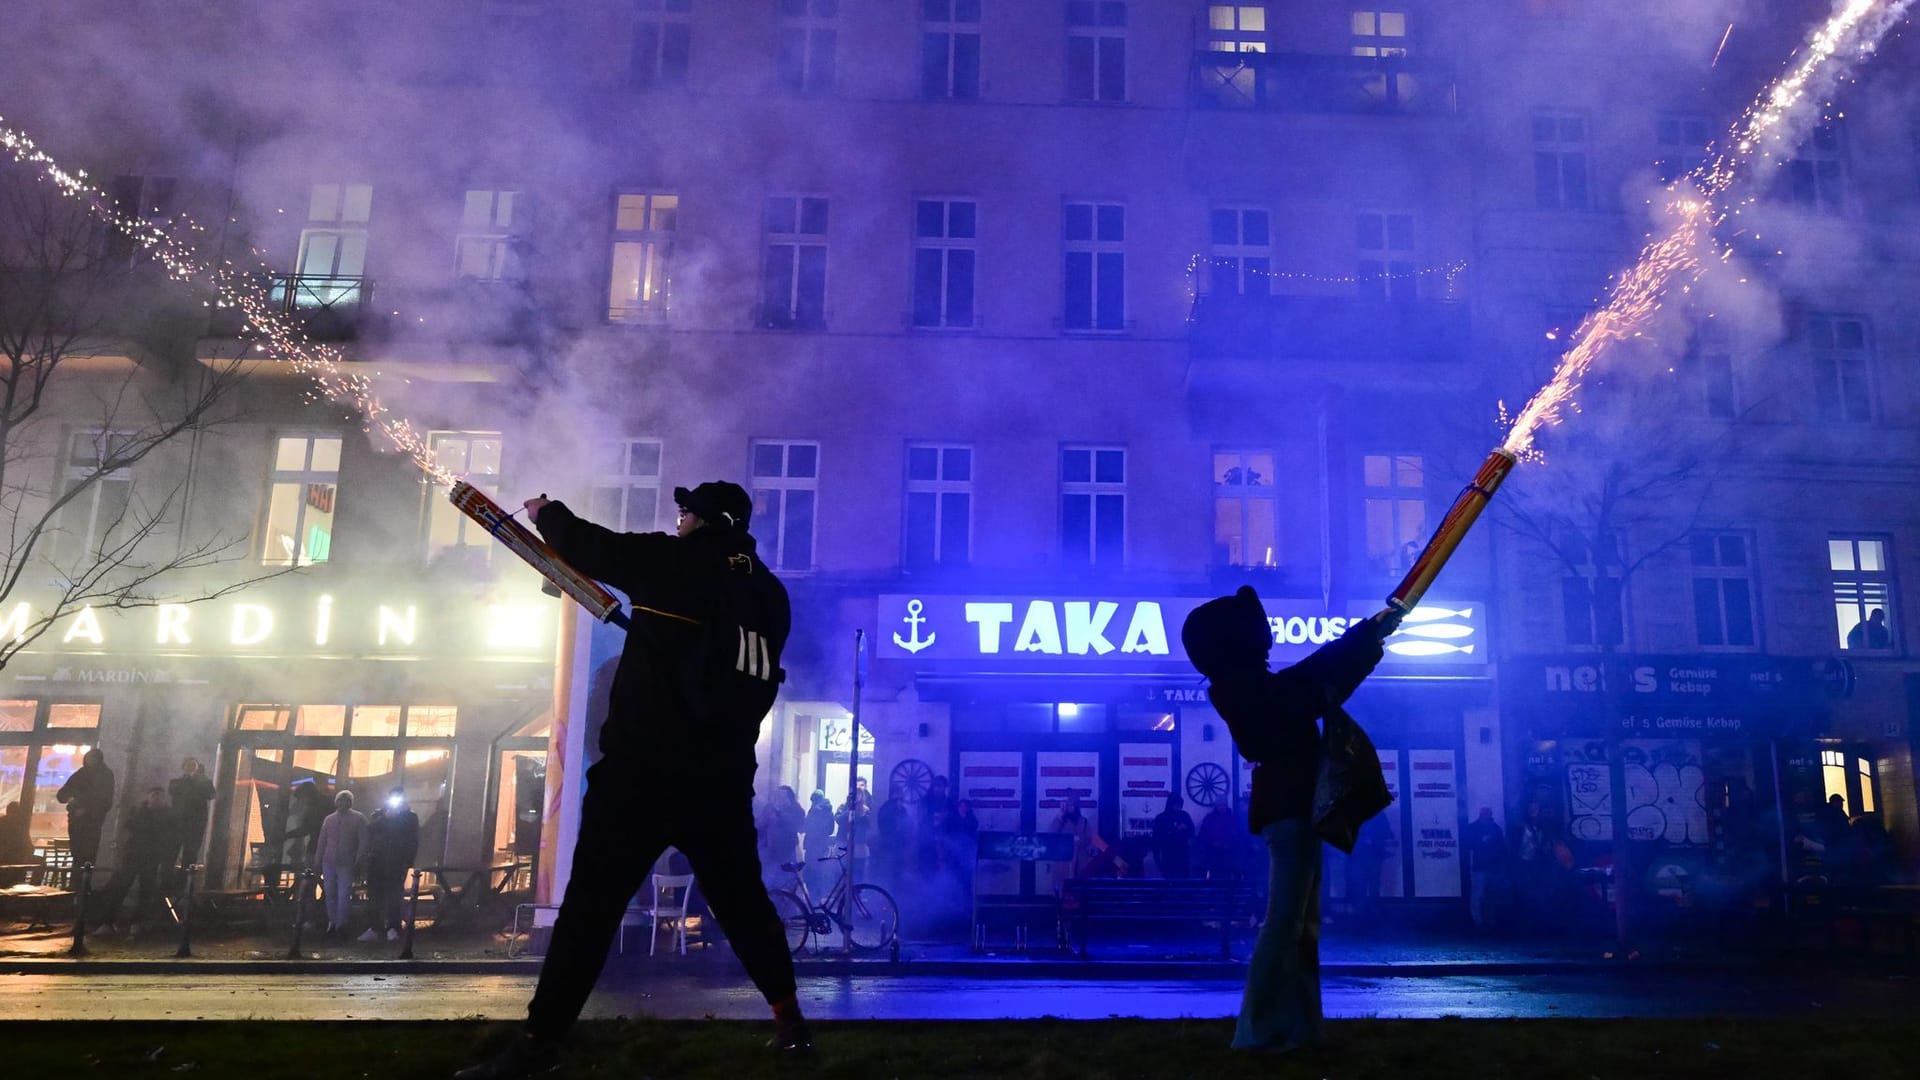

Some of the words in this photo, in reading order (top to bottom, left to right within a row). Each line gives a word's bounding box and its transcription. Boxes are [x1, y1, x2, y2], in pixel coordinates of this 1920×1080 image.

[965, 600, 1169, 655] TAKA
[1267, 616, 1362, 645] HOUS
[1669, 667, 1718, 679] Gemüse
[1164, 690, 1206, 701] TAKA
[1670, 682, 1712, 696] Kebap
[1656, 716, 1702, 729] Gemüse
[1707, 716, 1742, 730] Kebap
